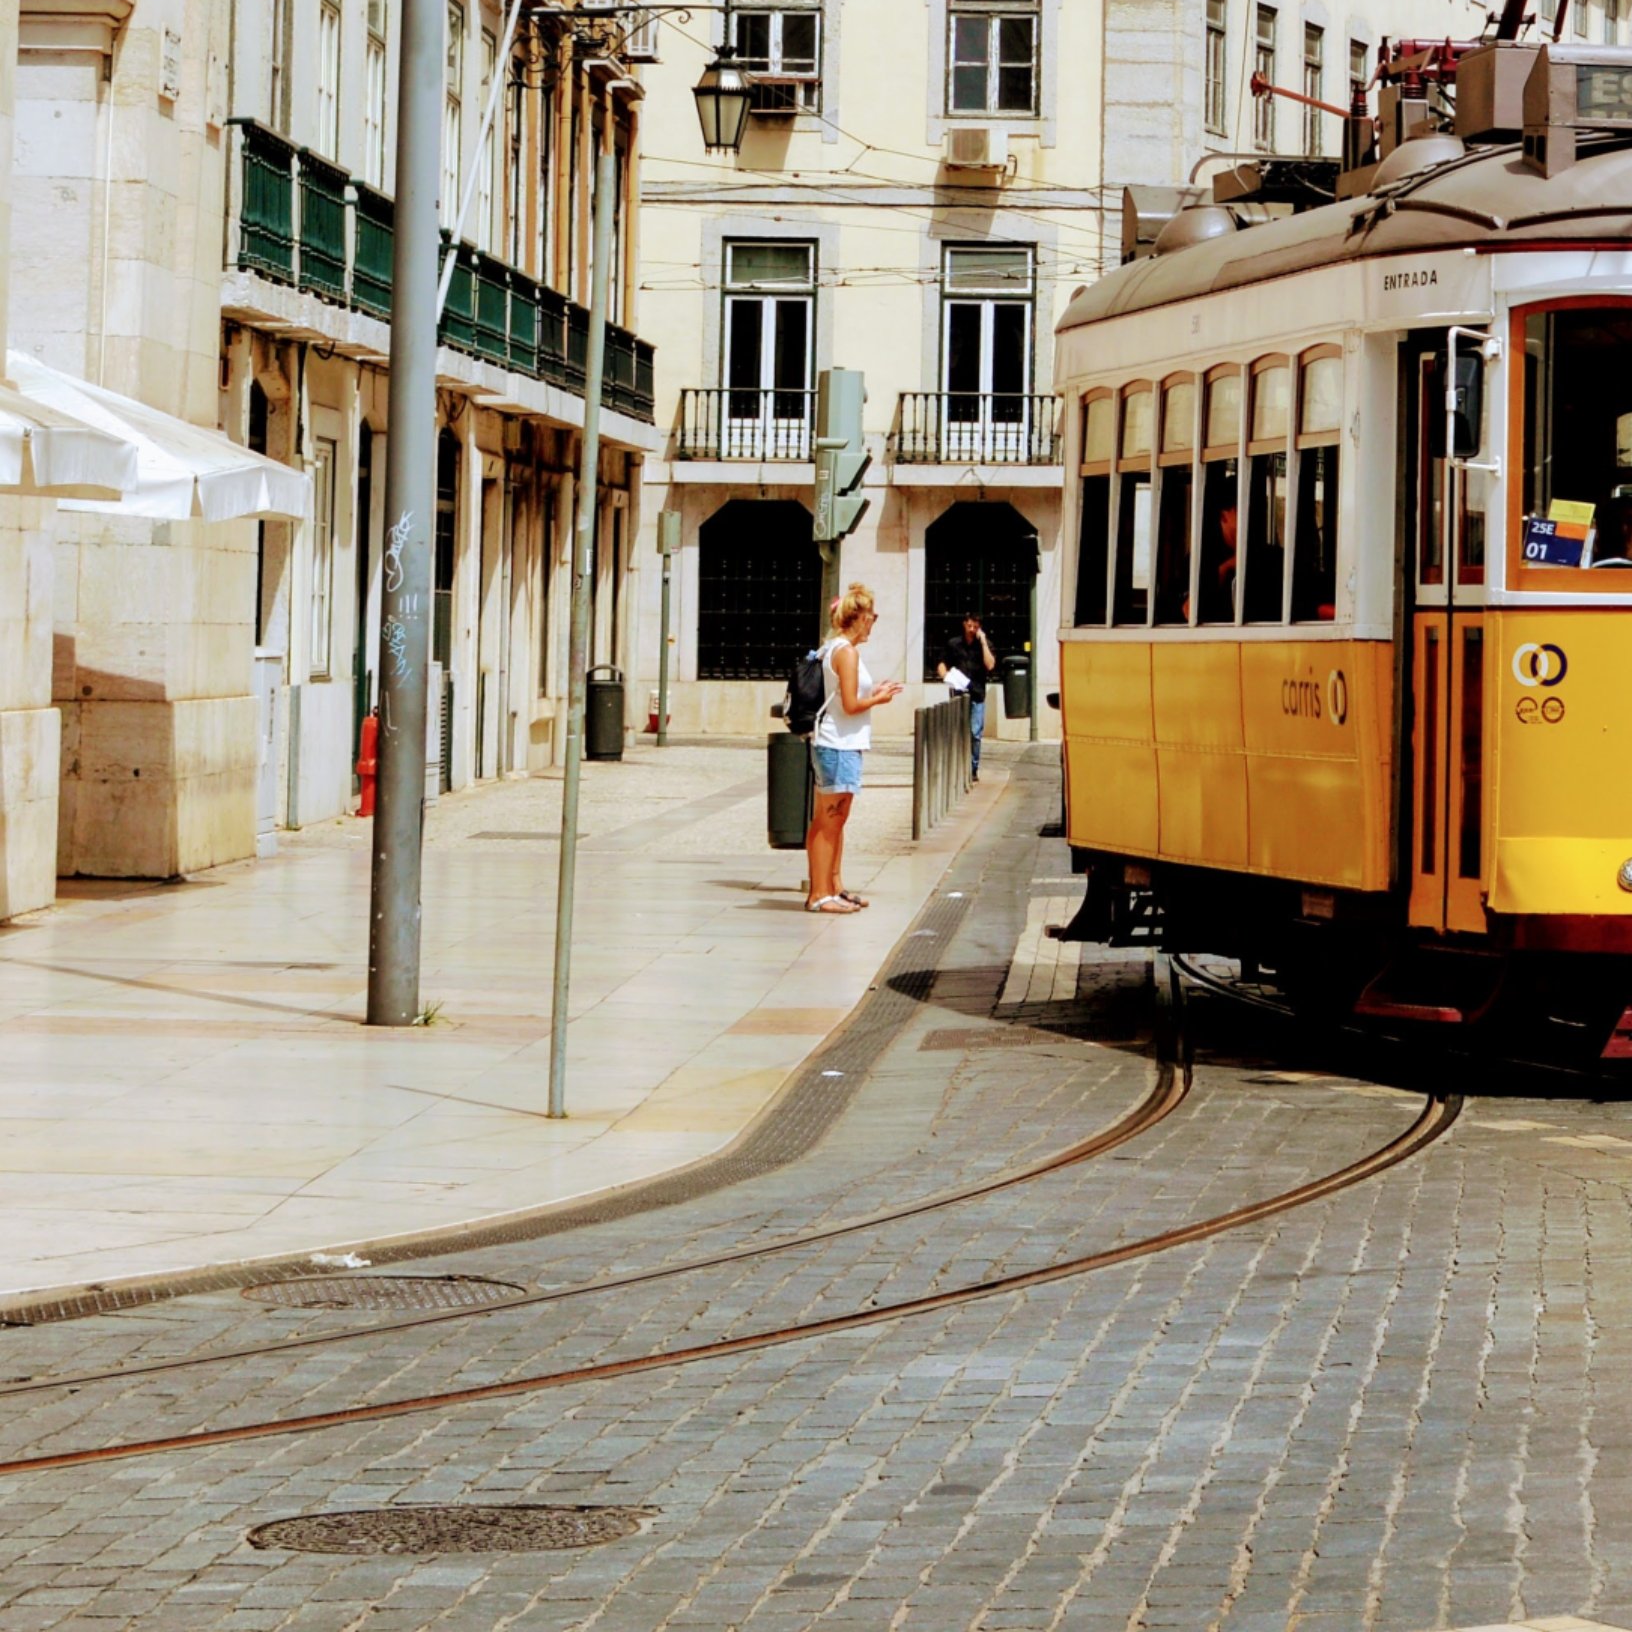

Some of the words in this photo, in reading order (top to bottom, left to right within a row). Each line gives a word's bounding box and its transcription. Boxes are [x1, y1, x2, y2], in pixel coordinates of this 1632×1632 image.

[1383, 270, 1438, 291] ENTRADA
[1531, 521, 1555, 536] 25E
[1525, 542, 1548, 560] 01
[1282, 665, 1322, 720] carris
